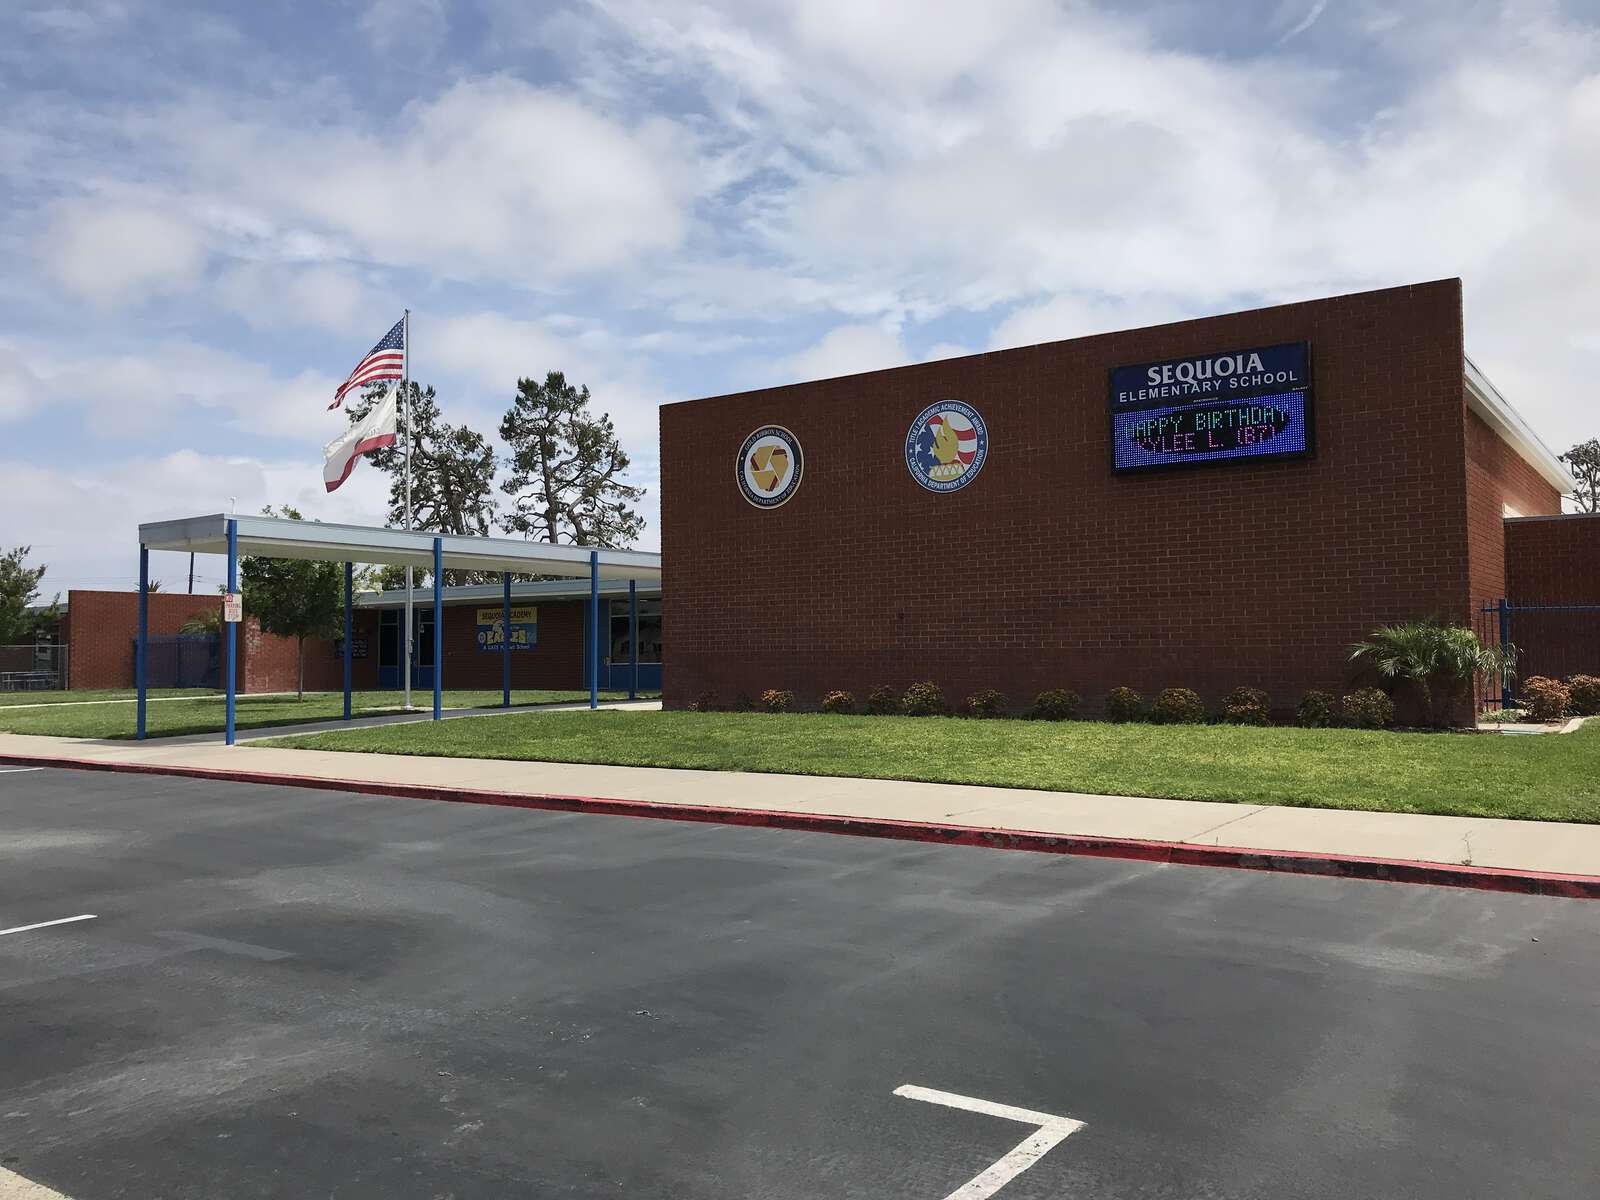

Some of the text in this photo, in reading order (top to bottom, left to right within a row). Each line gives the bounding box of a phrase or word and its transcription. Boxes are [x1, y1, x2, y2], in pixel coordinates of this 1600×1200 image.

[1147, 352, 1265, 386] SEQUOIA
[1119, 370, 1298, 403] ELEMENTARY SCHOOL
[918, 405, 941, 427] ACADEMIC
[940, 403, 974, 418] ACHIEVEMENT
[971, 416, 984, 435] AWARD
[1125, 404, 1289, 438] HAPPY BIRTHDAY
[775, 429, 793, 445] SCHOOL
[909, 449, 985, 490] CALIFORNIA DEPARTMENT OF EDUCATION
[752, 495, 781, 505] DEPARTMENT
[510, 608, 532, 618] CADEMY
